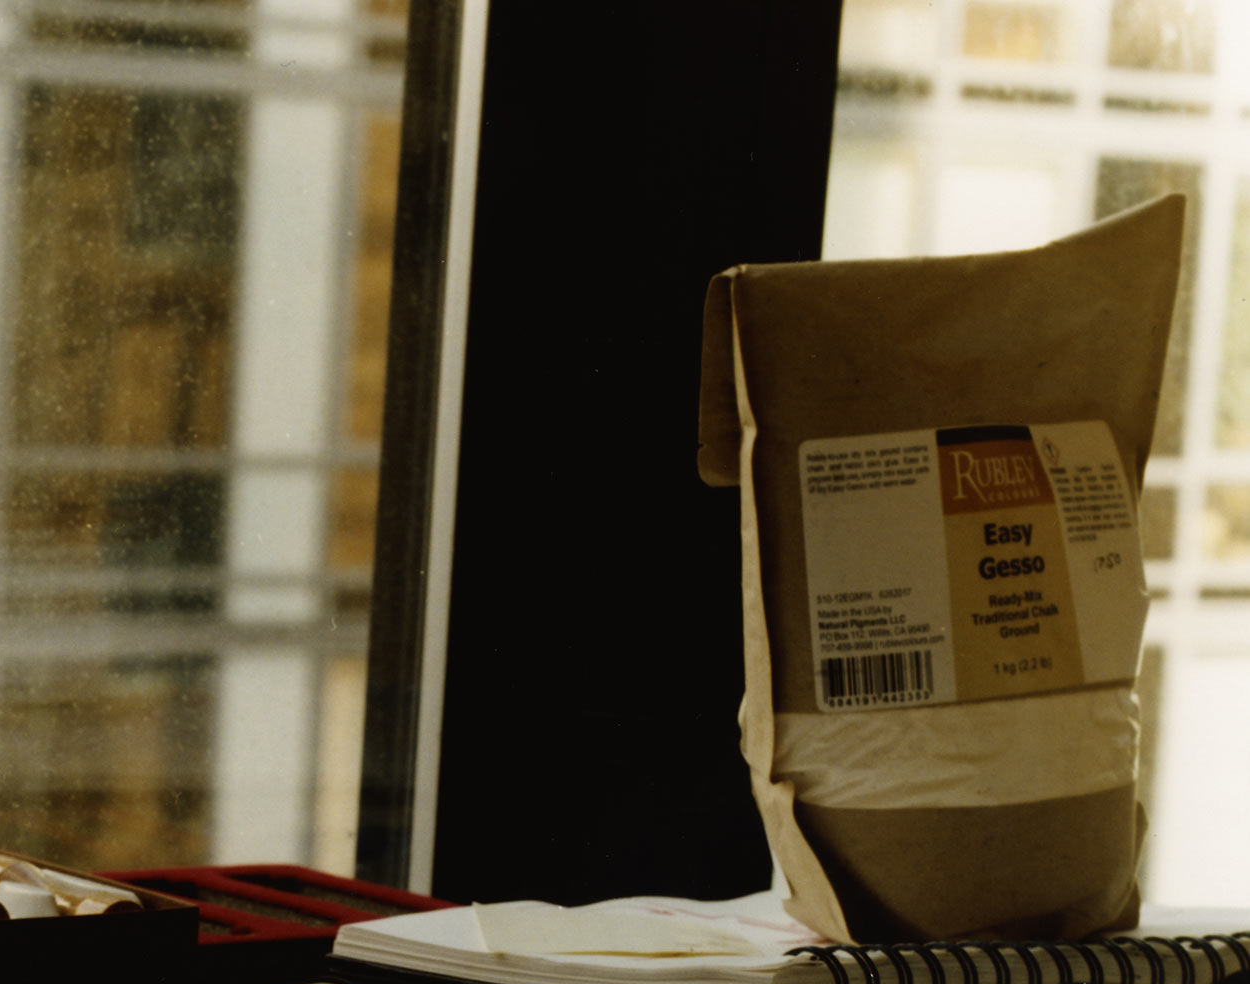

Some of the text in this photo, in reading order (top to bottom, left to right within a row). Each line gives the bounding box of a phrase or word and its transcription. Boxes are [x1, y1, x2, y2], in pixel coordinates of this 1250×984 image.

[984, 522, 1033, 547] Easy
[978, 555, 1045, 580] Gesso
[989, 590, 1043, 608] Ready-Mix
[818, 609, 839, 619] Made
[850, 607, 862, 616] the
[972, 604, 1059, 626] Traditional Chalk
[818, 614, 906, 630] Natural Pigments LLC
[834, 630, 848, 640] Box
[999, 623, 1040, 639] Ground
[1003, 662, 1016, 676] kg
